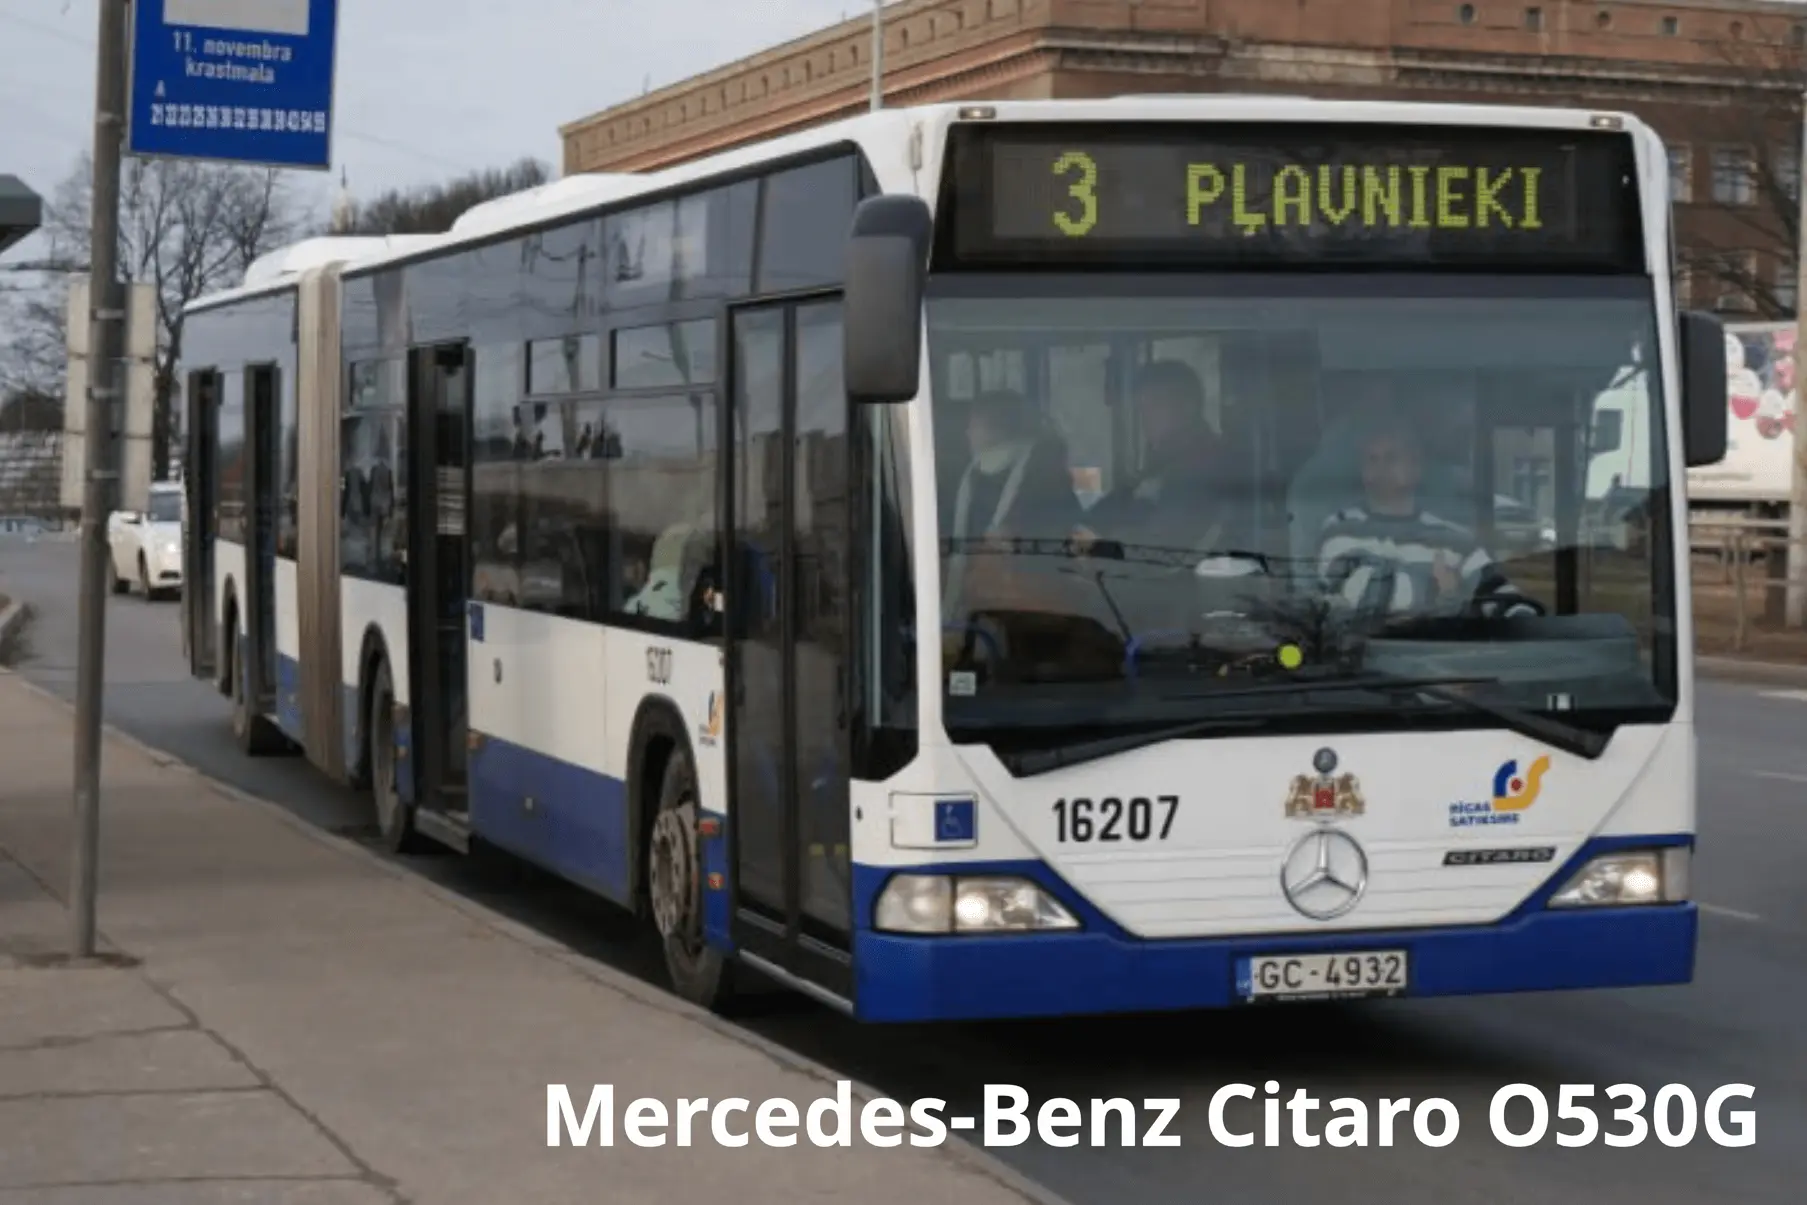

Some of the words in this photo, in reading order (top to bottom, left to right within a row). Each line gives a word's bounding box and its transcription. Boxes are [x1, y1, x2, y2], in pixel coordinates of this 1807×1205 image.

[172, 29, 198, 53] 11.
[203, 38, 293, 62] novembra
[185, 55, 276, 84] krastmala
[1051, 153, 1098, 236] 3
[1186, 162, 1541, 237] PĻAVNIEKI
[1051, 794, 1180, 842] 16207
